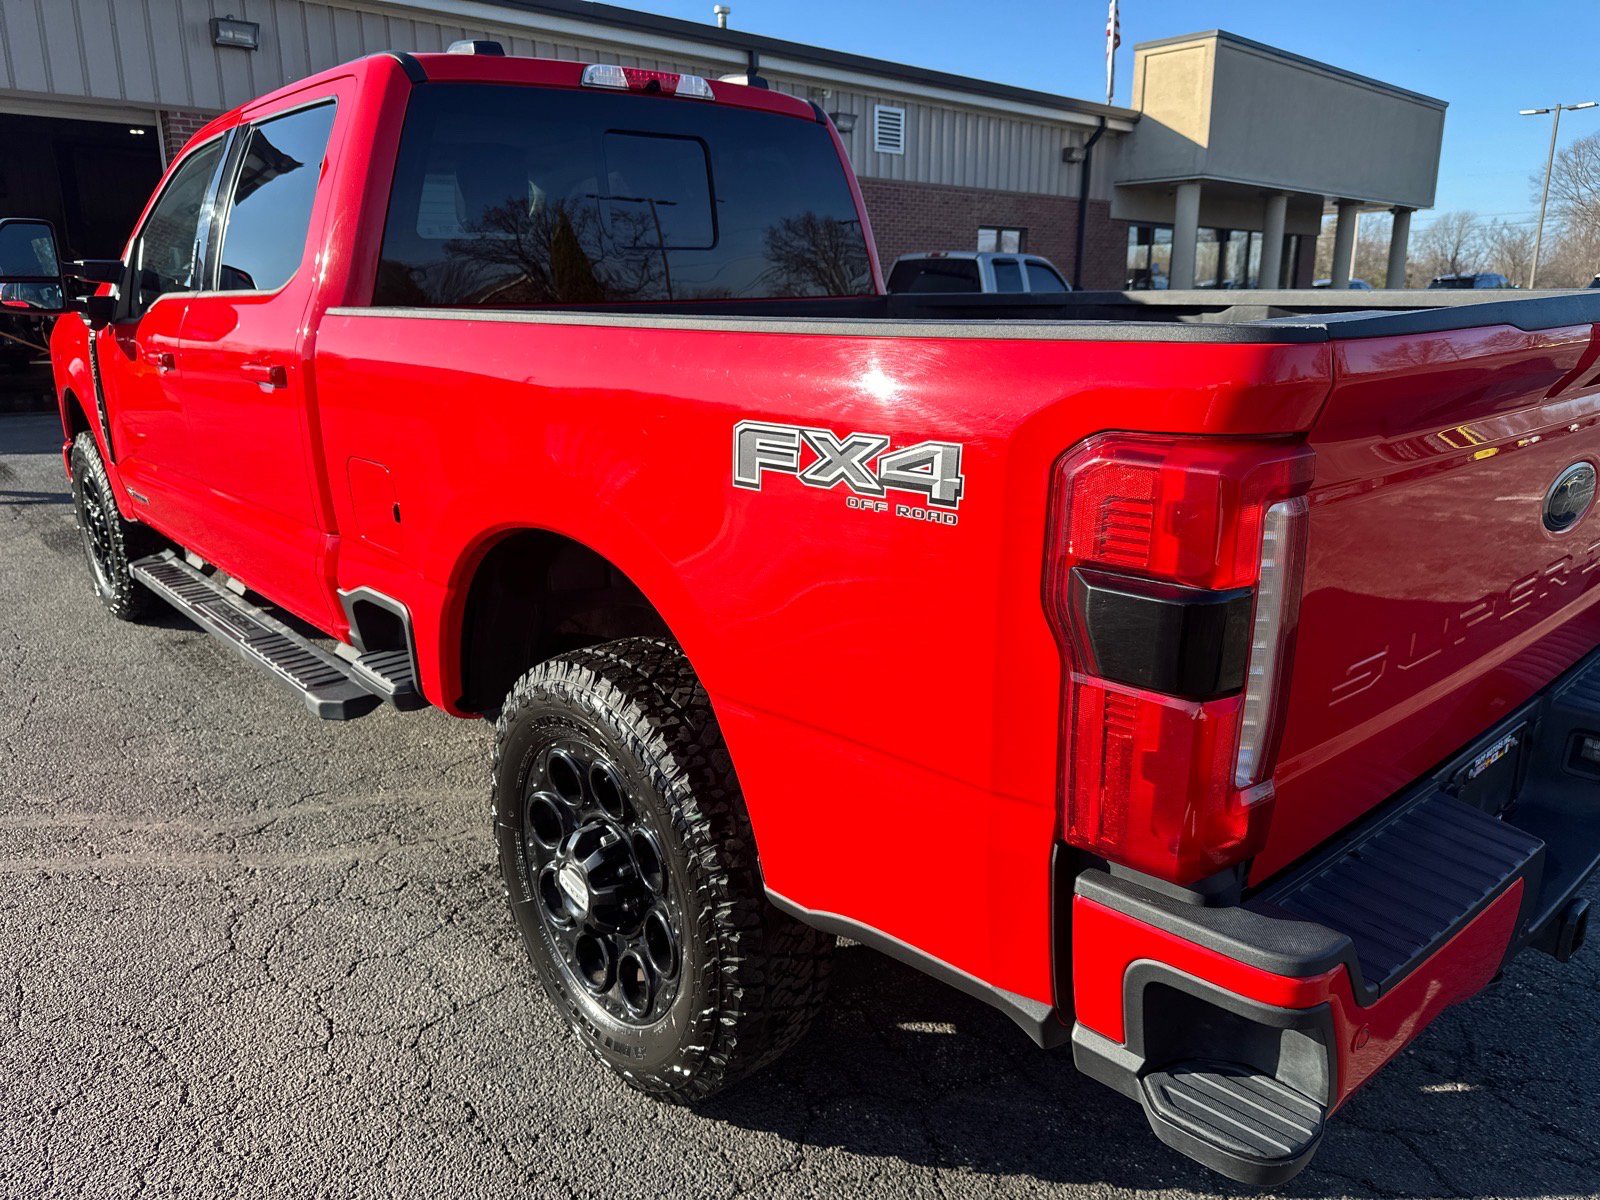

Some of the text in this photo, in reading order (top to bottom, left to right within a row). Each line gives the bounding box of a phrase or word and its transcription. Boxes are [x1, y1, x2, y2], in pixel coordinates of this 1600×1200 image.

[733, 419, 965, 510] FX4
[846, 496, 958, 526] OFF ROAD
[1329, 554, 1573, 707] SUPER
